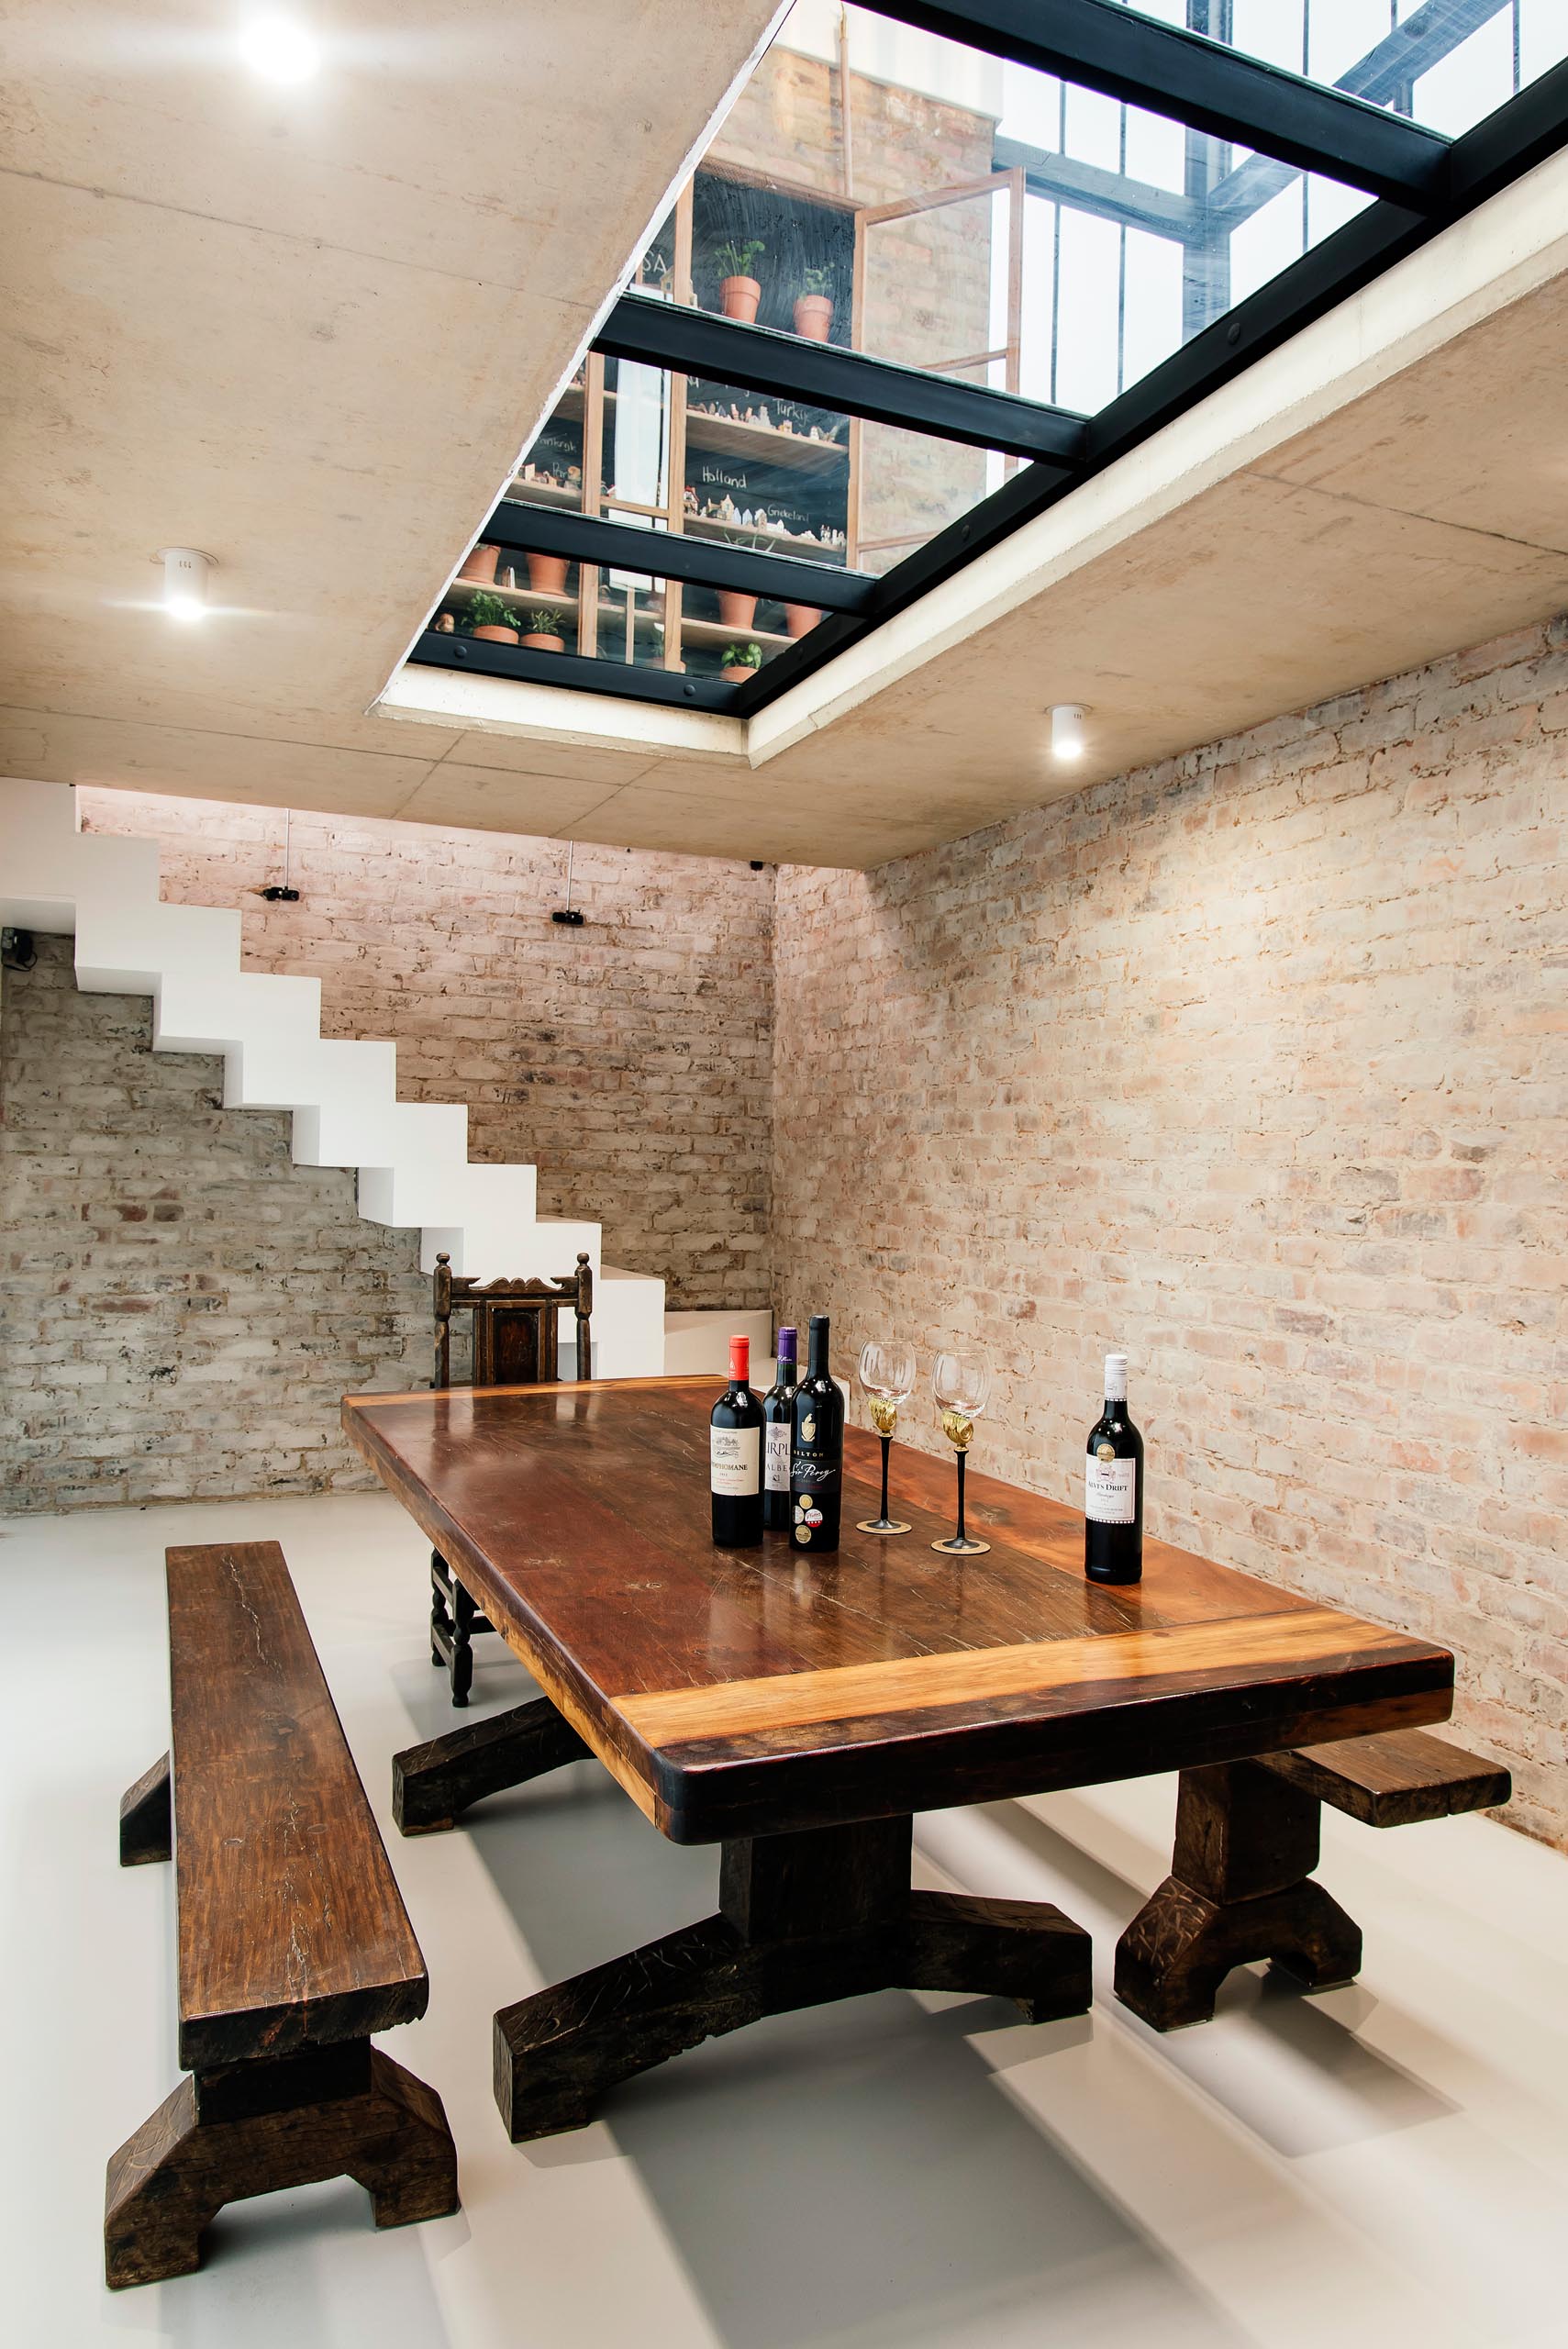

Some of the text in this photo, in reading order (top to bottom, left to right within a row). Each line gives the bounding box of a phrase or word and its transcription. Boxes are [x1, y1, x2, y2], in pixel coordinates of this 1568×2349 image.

[702, 465, 747, 489] Holland
[801, 1464, 836, 1482] Percy
[1106, 1483, 1129, 1491] DRIFT
